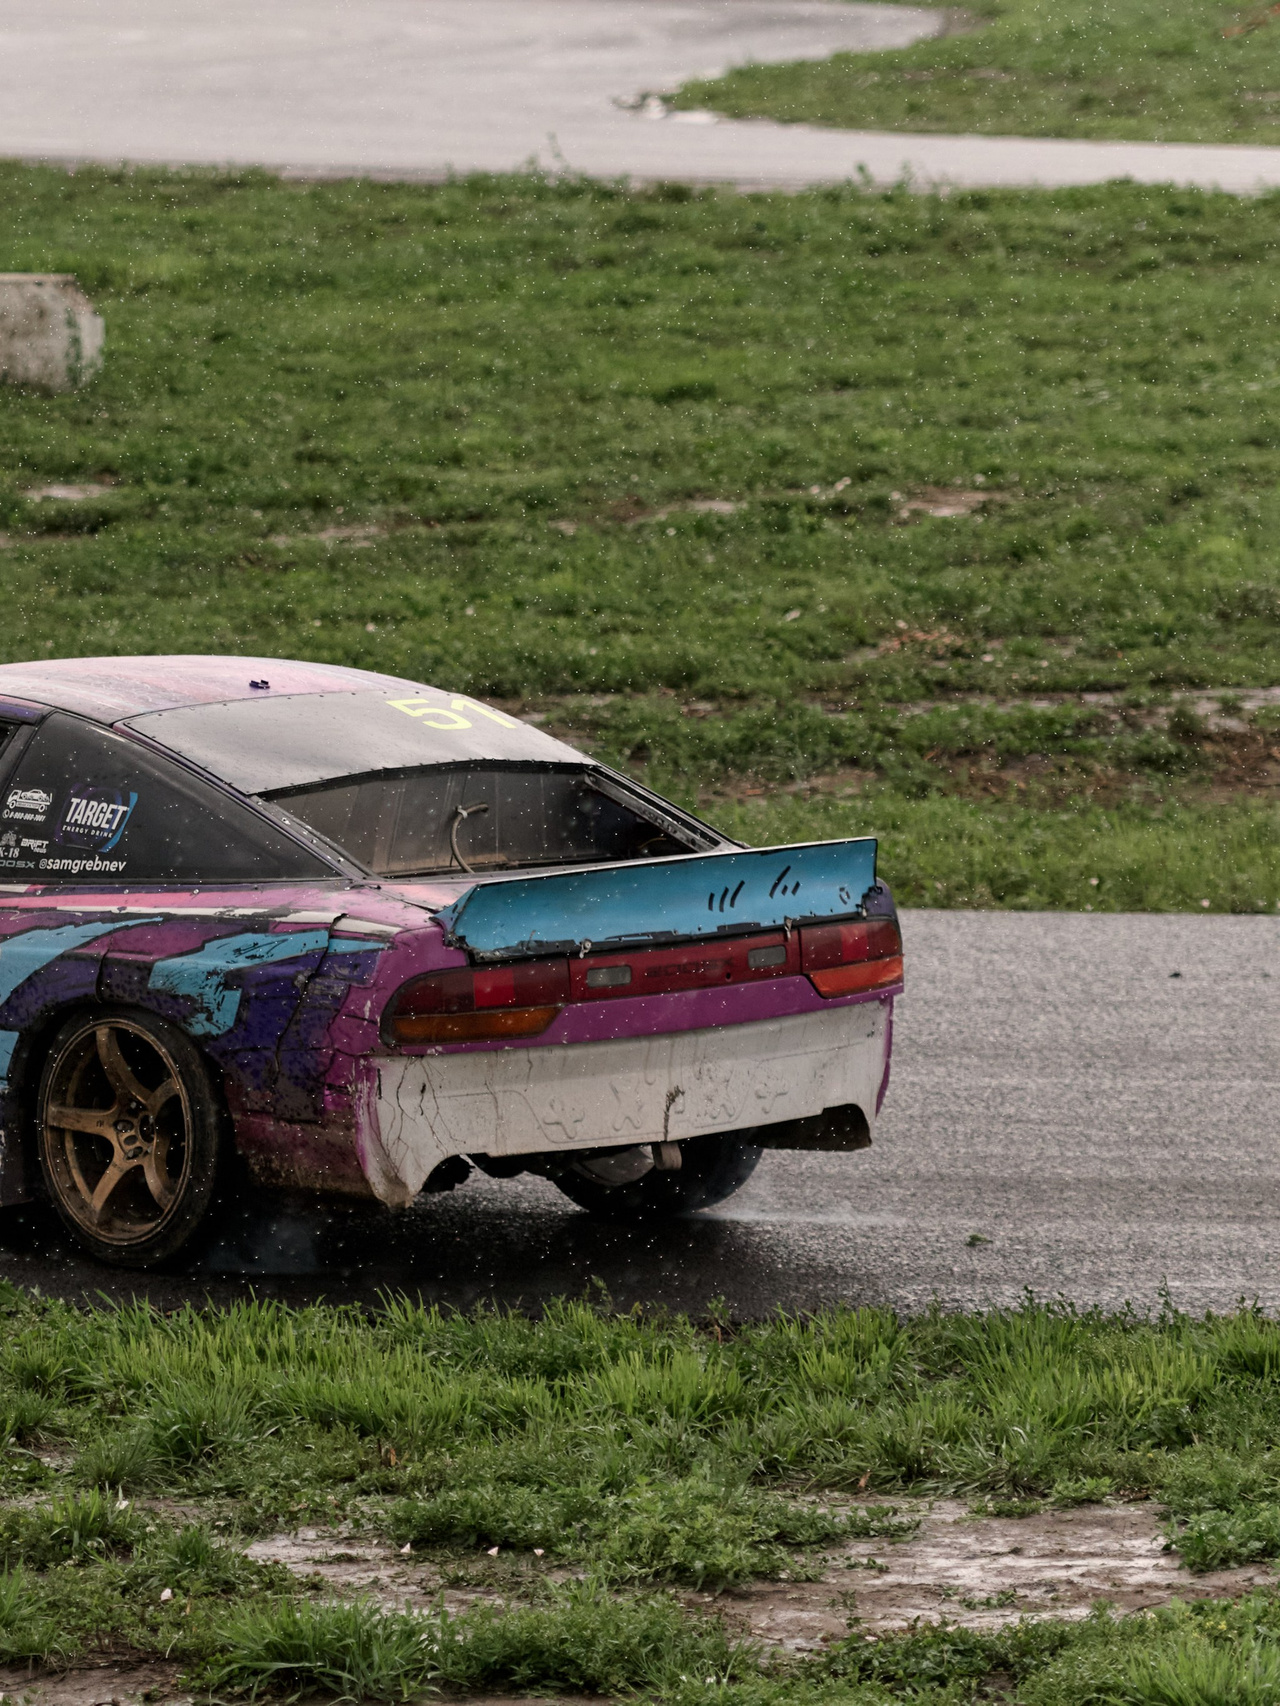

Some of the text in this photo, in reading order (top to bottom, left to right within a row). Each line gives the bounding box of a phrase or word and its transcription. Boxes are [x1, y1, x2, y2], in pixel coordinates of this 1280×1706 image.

[385, 699, 517, 730] 51
[65, 797, 128, 830] TARGET
[62, 825, 113, 838] ENERGY DRINK
[39, 856, 126, 873] @samgrebnev
